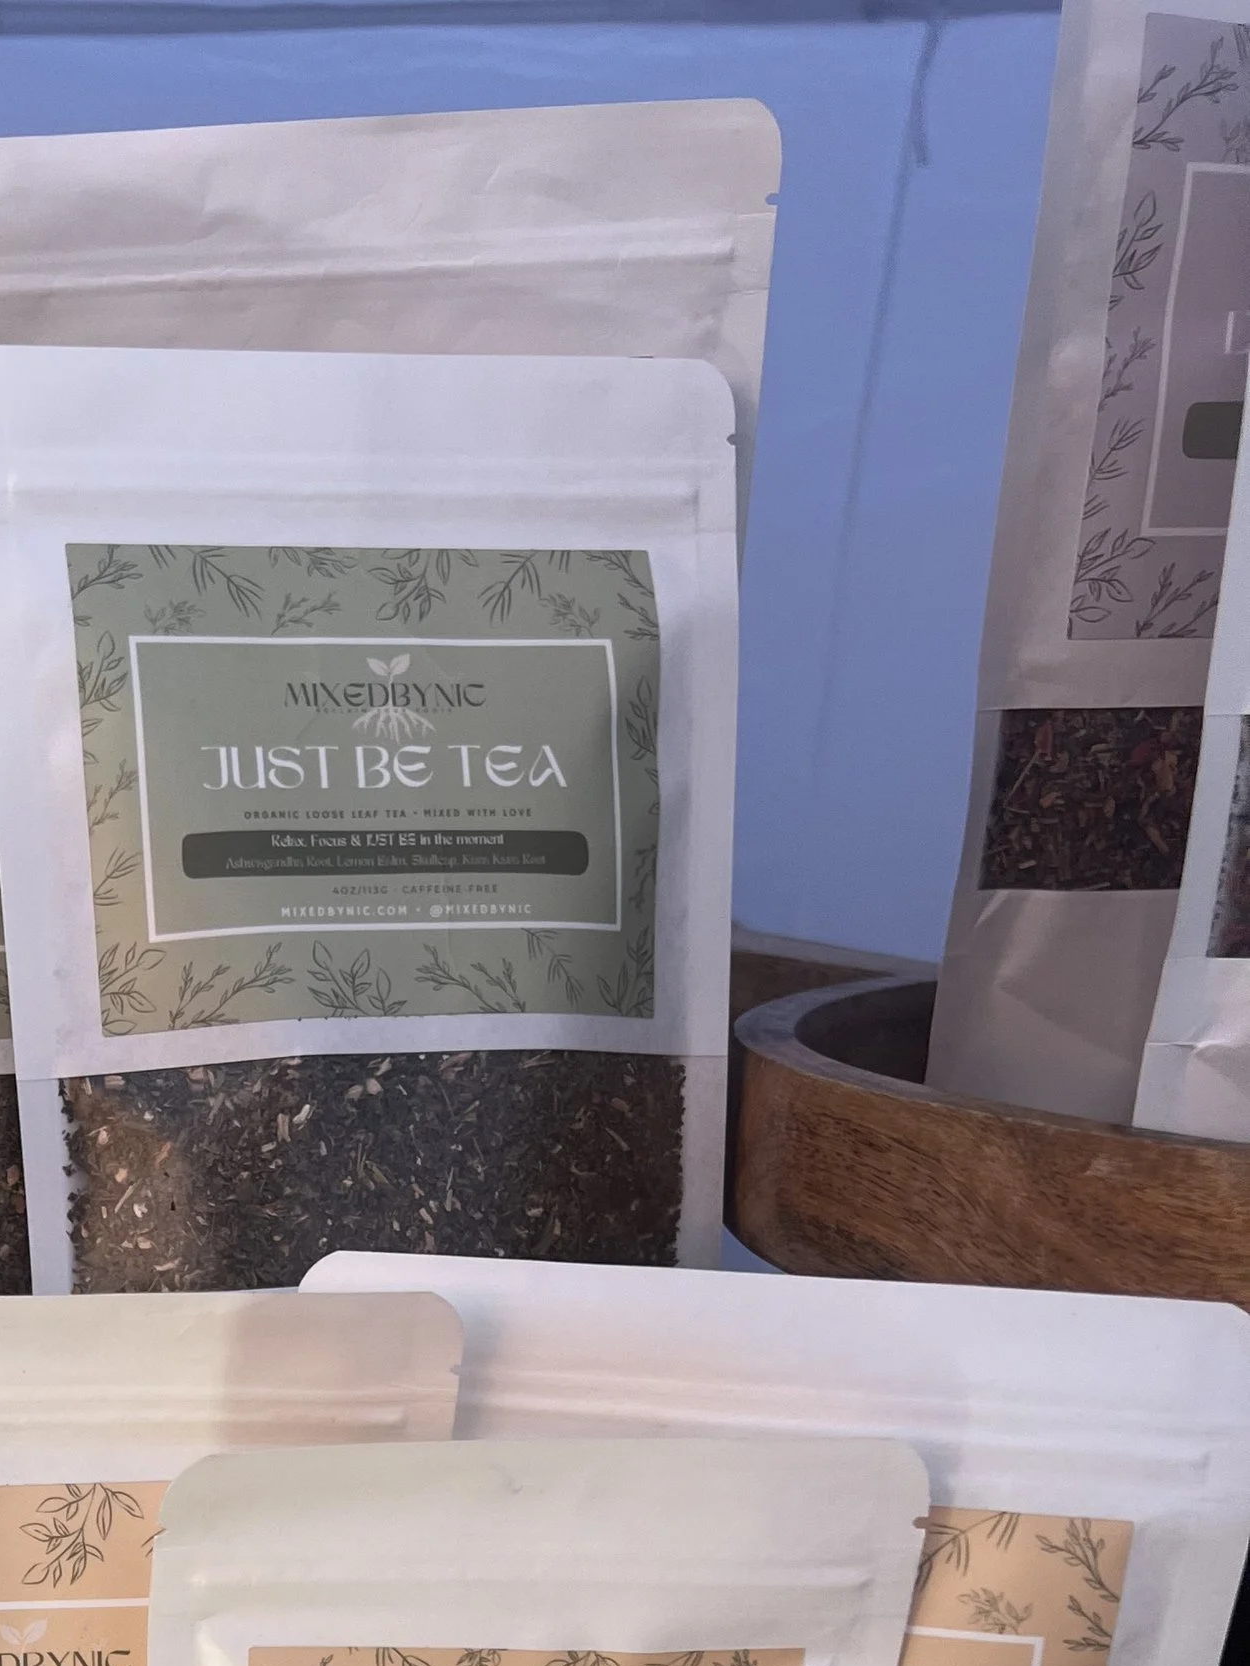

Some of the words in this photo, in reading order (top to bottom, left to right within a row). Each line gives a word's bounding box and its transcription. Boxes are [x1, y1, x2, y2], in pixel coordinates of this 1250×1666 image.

[284, 682, 486, 708] MIXEDBYNIC
[201, 745, 338, 790] JUST
[355, 745, 433, 789] BE
[448, 745, 567, 788] TEA
[244, 810, 299, 820] ORGANIC
[306, 810, 344, 819] LOOSE
[352, 810, 378, 818] LEAF
[386, 810, 406, 818] TEA
[424, 809, 460, 817] MIXED
[468, 809, 496, 817] WITH
[503, 808, 531, 816] LOVE
[281, 905, 407, 918] MIXEDBYNIC.COM
[430, 904, 531, 918] @MIXEDBYNIC
